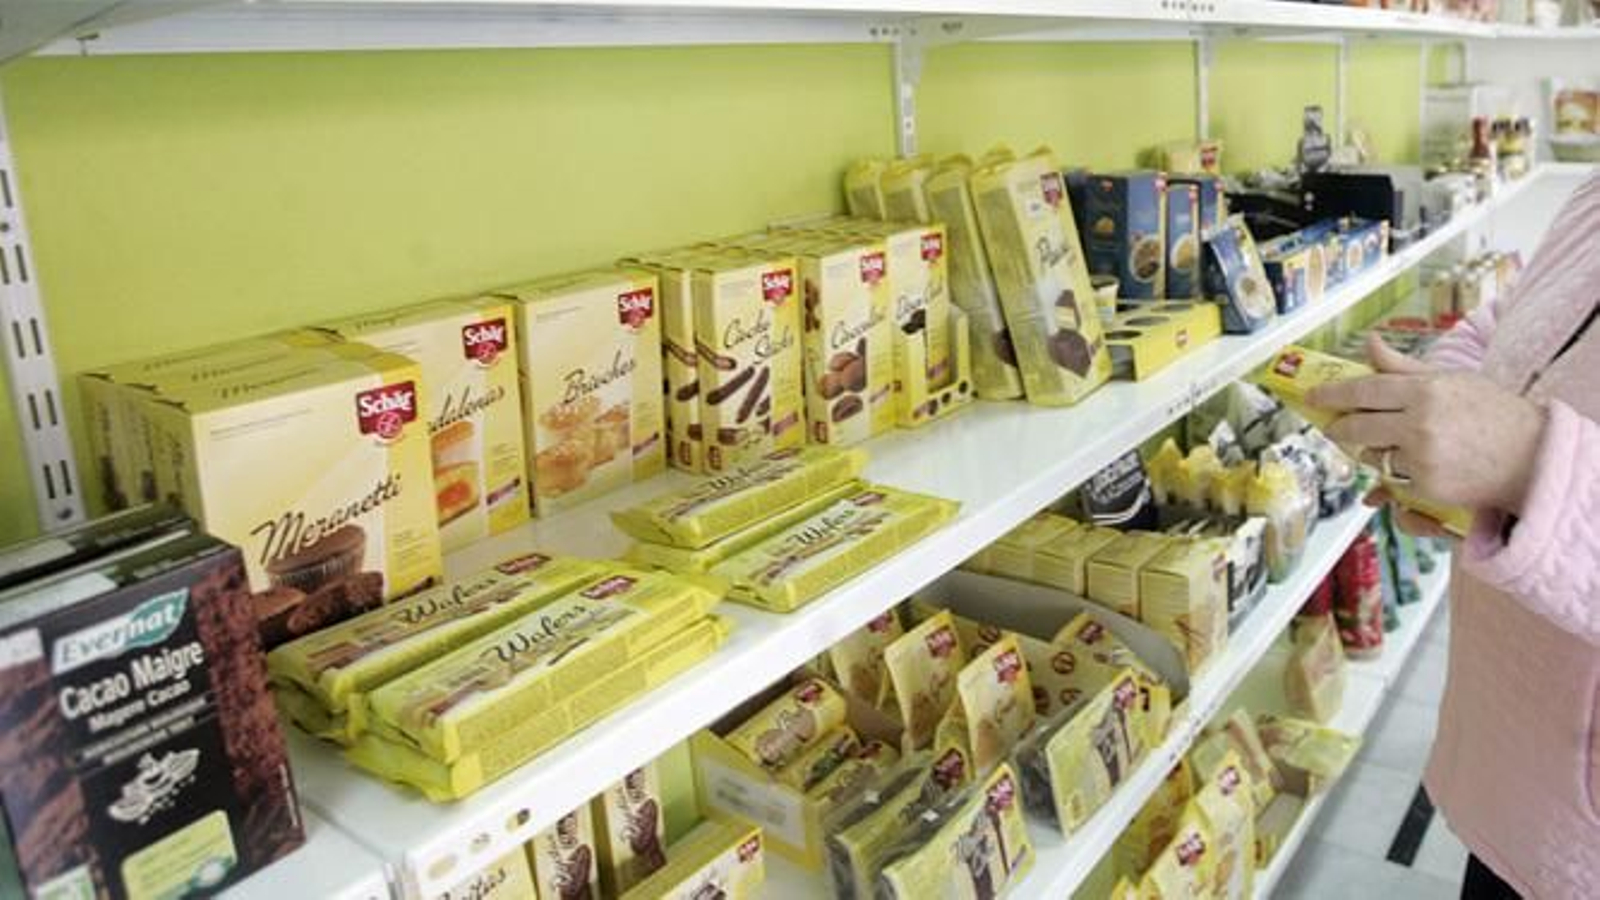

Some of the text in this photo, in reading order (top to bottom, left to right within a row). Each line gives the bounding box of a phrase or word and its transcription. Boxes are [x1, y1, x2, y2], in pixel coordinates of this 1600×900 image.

[360, 388, 413, 418] Schär
[250, 473, 402, 568] Meranetti
[60, 601, 178, 666] Evernat
[493, 603, 587, 663] Wafers
[60, 641, 205, 720] Cacao Maigre
